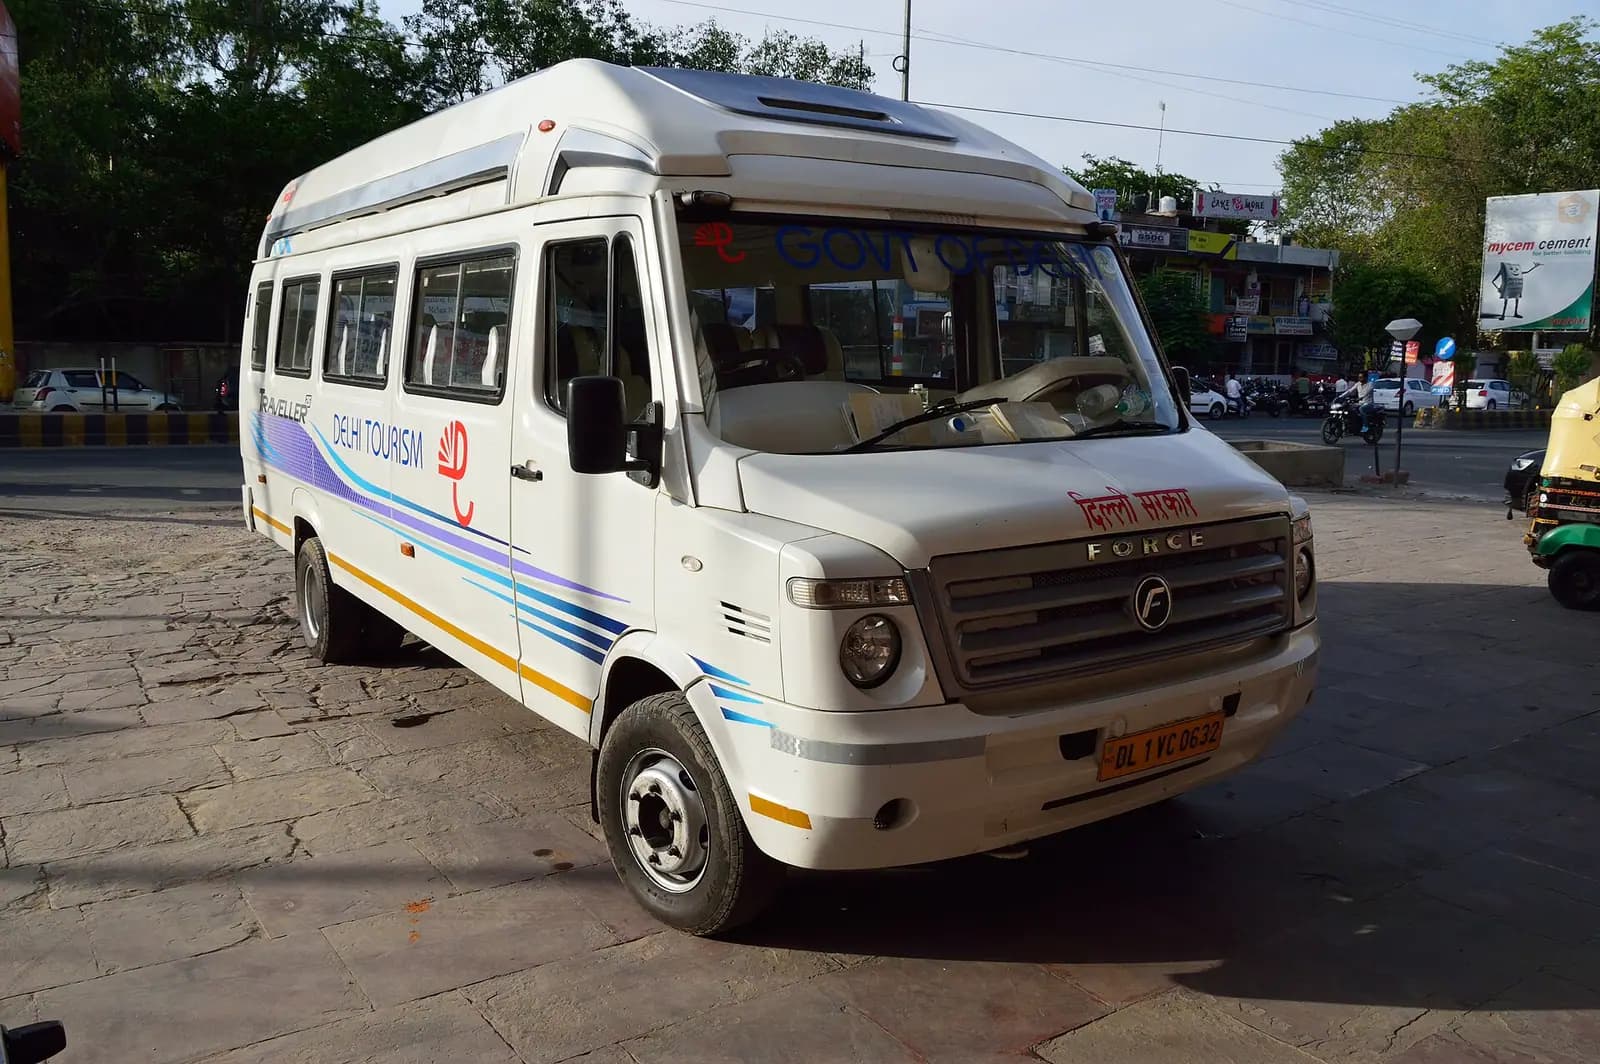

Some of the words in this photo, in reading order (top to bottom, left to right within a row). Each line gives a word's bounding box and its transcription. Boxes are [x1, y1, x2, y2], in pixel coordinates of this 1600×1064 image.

[775, 223, 916, 274] GOVT
[935, 231, 990, 277] OF
[1487, 240, 1536, 255] mycem
[1538, 236, 1592, 250] cement
[259, 387, 308, 425] TRAVELLER
[333, 413, 362, 453] DELHI
[365, 419, 424, 470] TOURISM
[1066, 486, 1139, 532] दिल्ली
[1132, 488, 1198, 522] सरकार
[1087, 530, 1205, 561] FORCE
[1179, 720, 1220, 752] 0632
